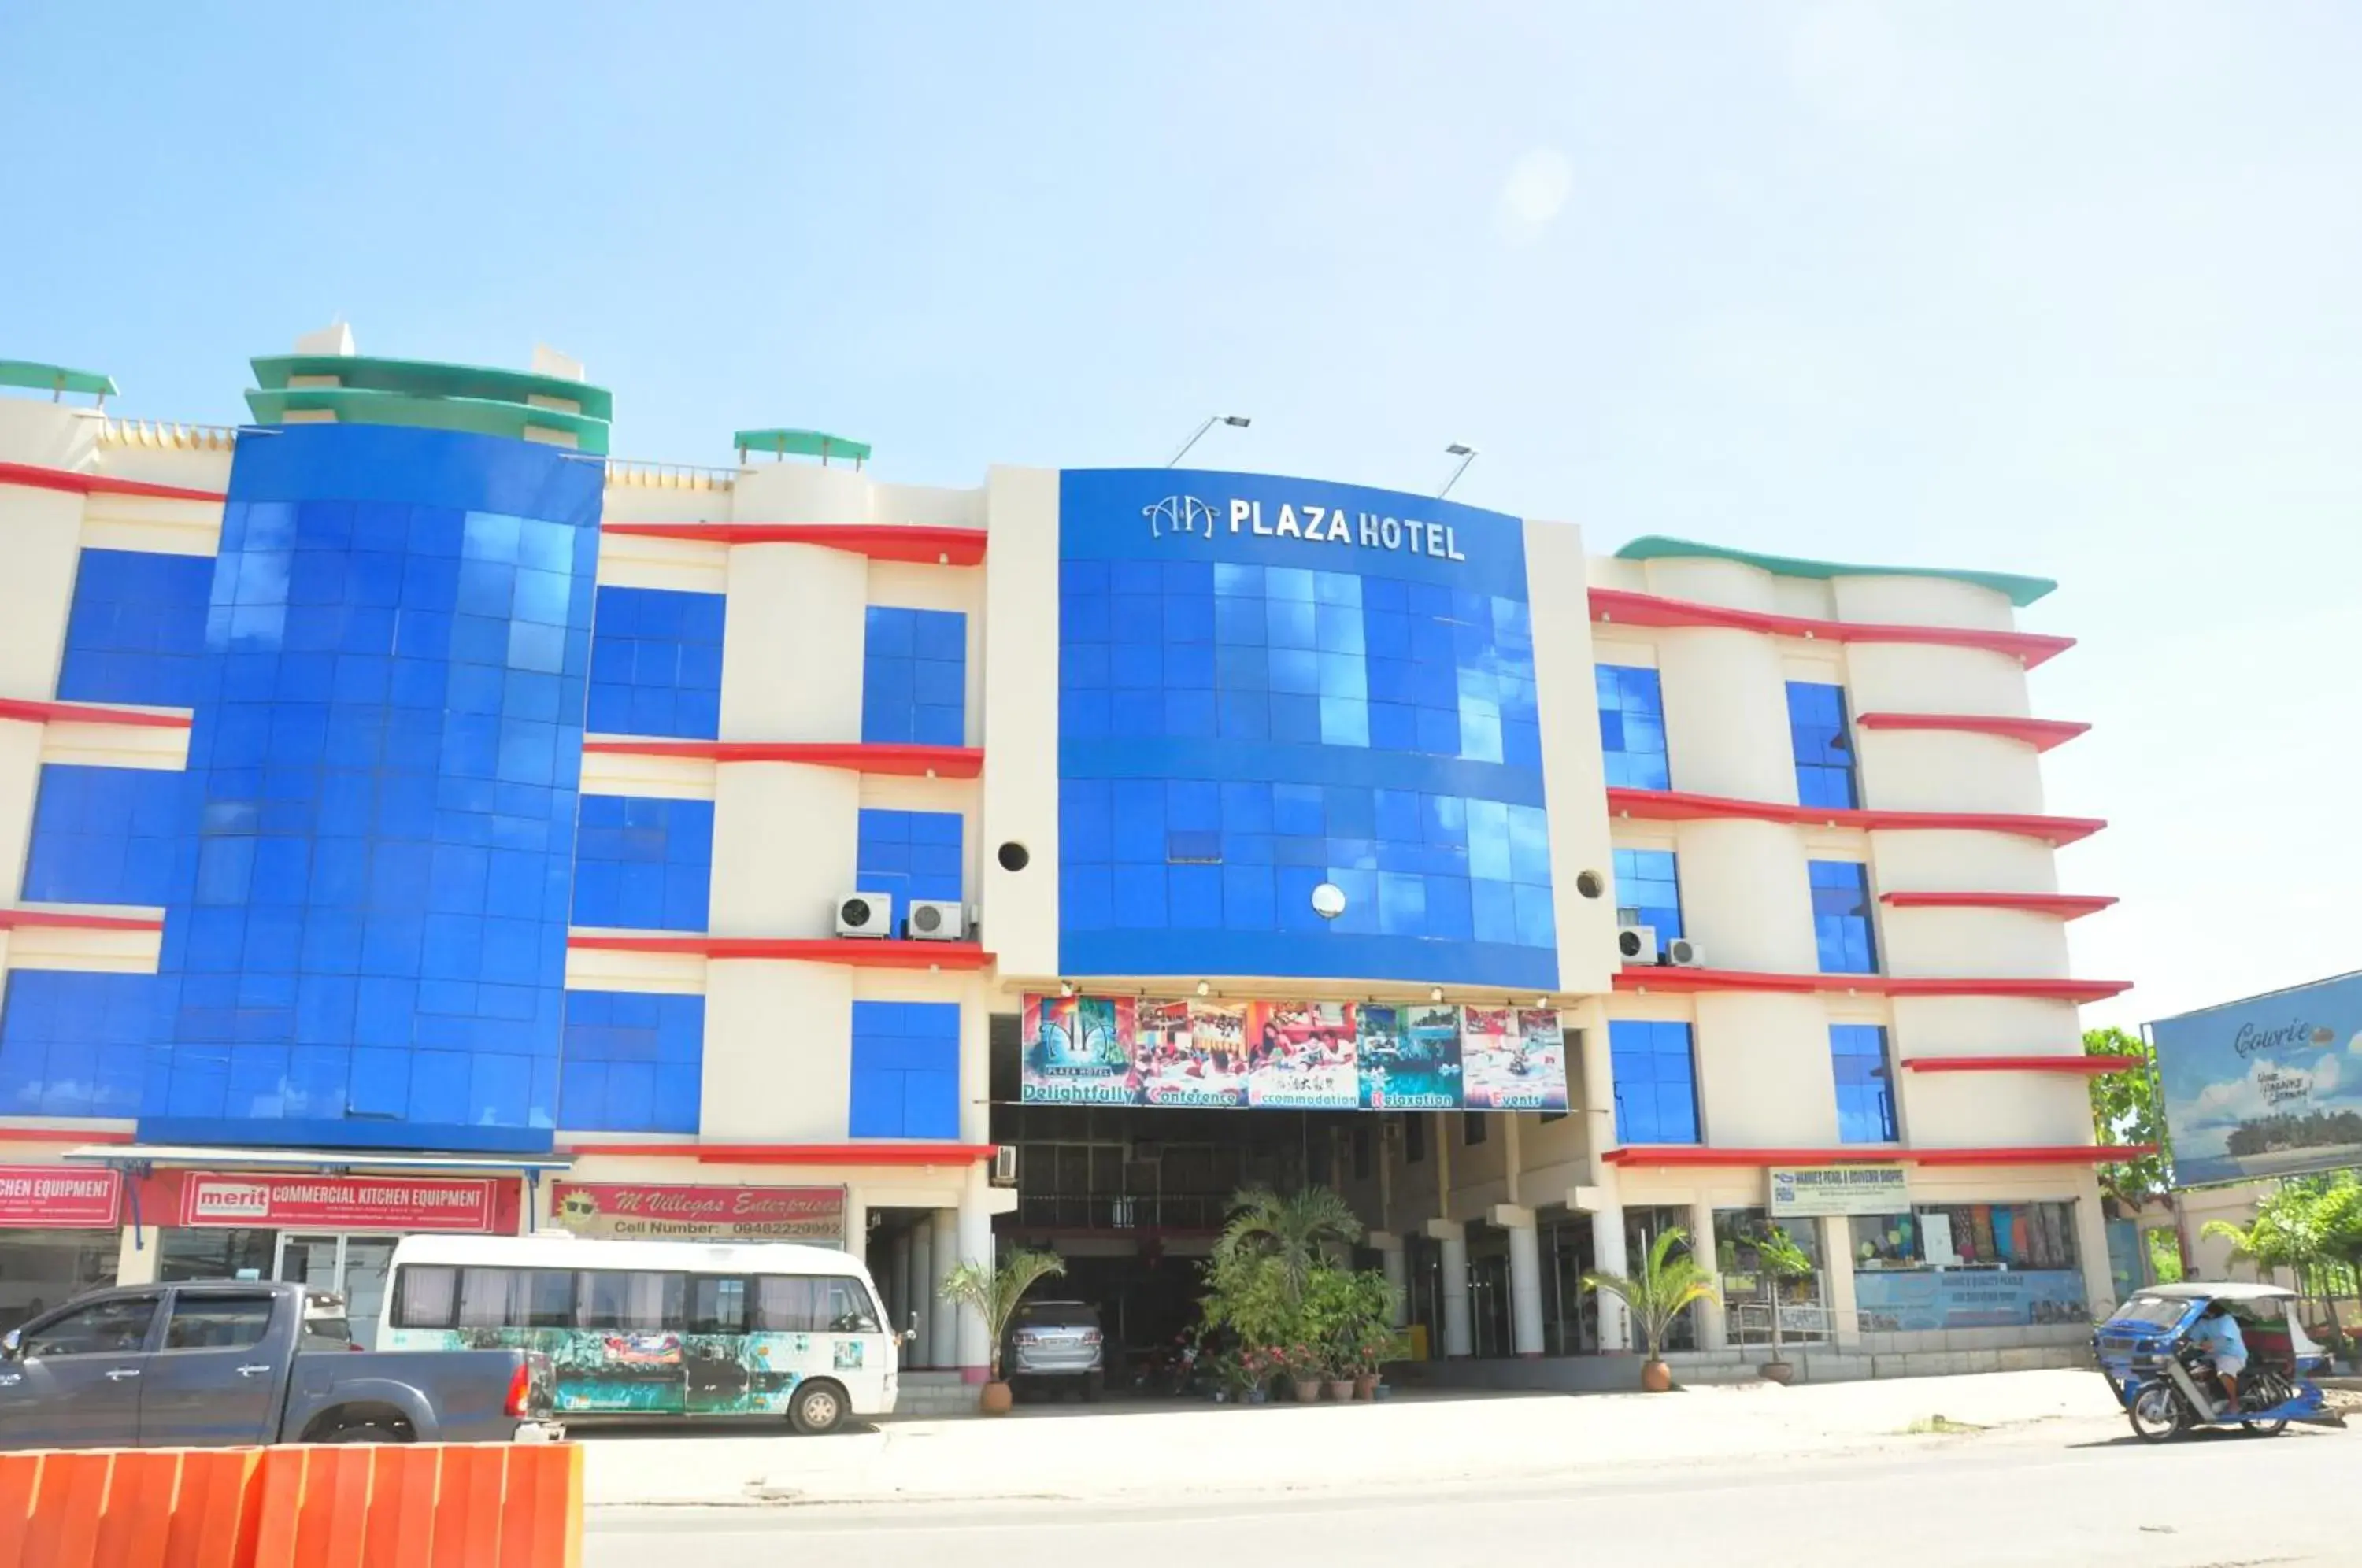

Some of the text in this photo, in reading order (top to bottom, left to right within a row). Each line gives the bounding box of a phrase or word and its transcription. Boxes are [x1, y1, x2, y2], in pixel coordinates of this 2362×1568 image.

[1229, 498, 1351, 544] PLAZA
[1359, 512, 1466, 561] HOTEL
[1023, 1084, 1135, 1104] Delightfully
[1150, 1088, 1238, 1104] Conference
[1372, 1091, 1453, 1108] Relaxation
[1492, 1091, 1541, 1107] Events
[34, 1179, 110, 1200] EQUIPMENT
[201, 1189, 266, 1206] merit
[273, 1185, 482, 1207] COMMERCIAL KITCHEN EQUIPMENT
[645, 1192, 724, 1218] Villegas
[731, 1192, 840, 1217] Enterprises
[614, 1222, 646, 1234] Cell
[650, 1222, 720, 1235] Number:
